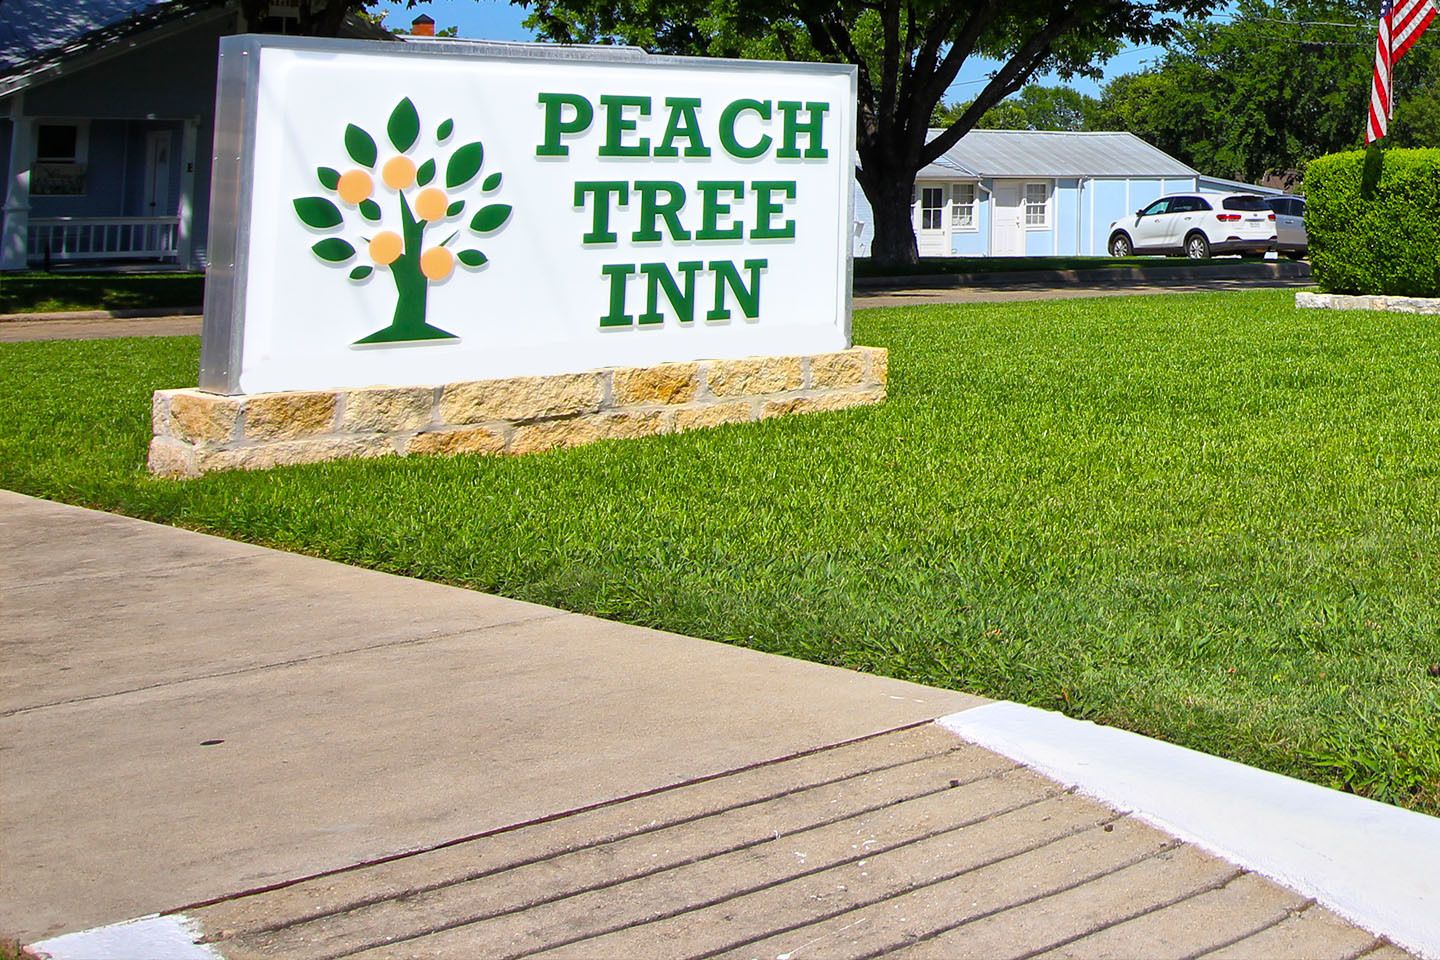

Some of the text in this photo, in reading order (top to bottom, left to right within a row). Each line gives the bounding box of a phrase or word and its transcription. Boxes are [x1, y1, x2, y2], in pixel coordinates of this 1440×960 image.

[536, 93, 830, 158] PEACH
[574, 181, 796, 243] TREE
[600, 259, 768, 327] INN
